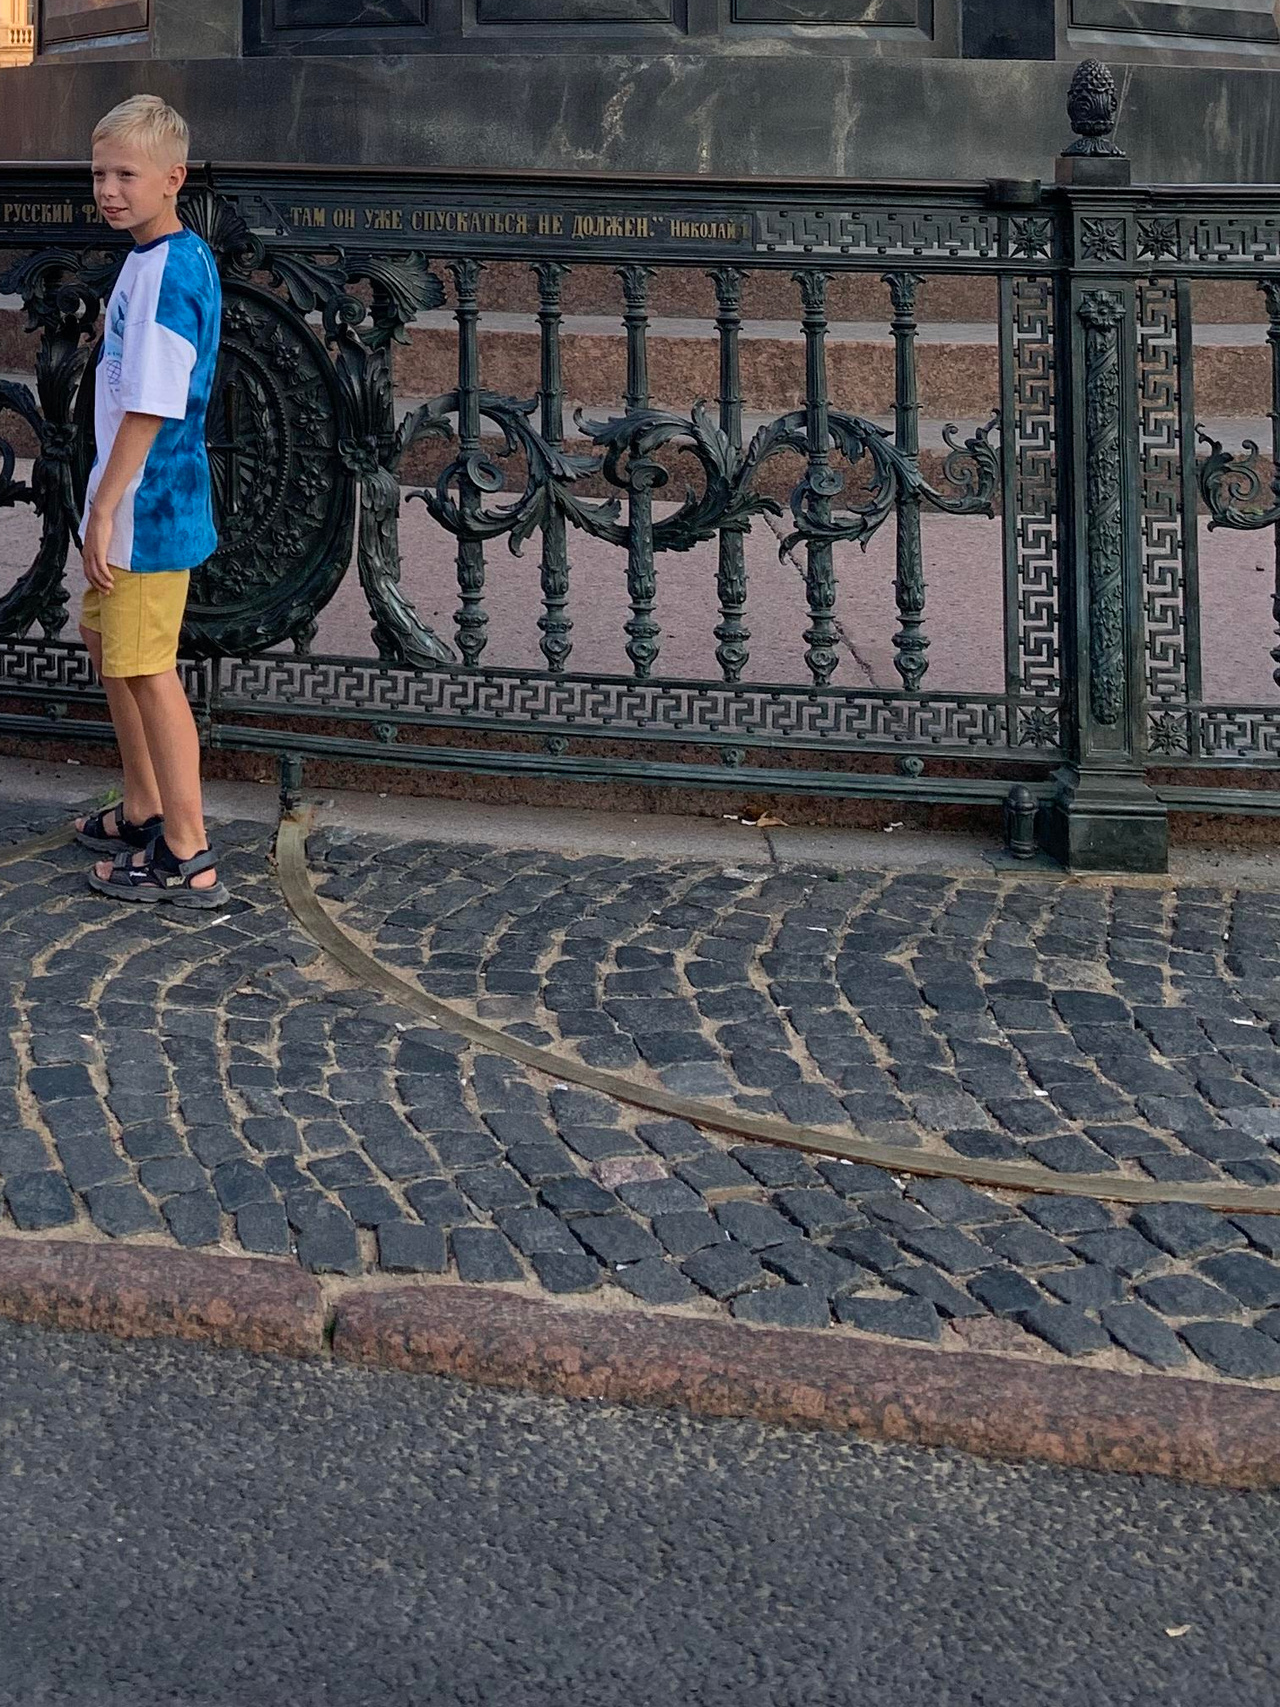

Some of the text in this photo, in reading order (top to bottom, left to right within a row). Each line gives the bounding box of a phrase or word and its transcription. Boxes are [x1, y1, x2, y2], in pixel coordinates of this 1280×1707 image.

[4, 199, 74, 224] РУССКИЙ
[290, 206, 326, 227] ТАМ
[332, 208, 355, 228] ОН
[364, 209, 403, 230] УЖЕ
[412, 211, 528, 234] СПУСКАТЬСЯ
[538, 214, 563, 235] НЕ
[670, 218, 737, 240] НИКОЛАЙ
